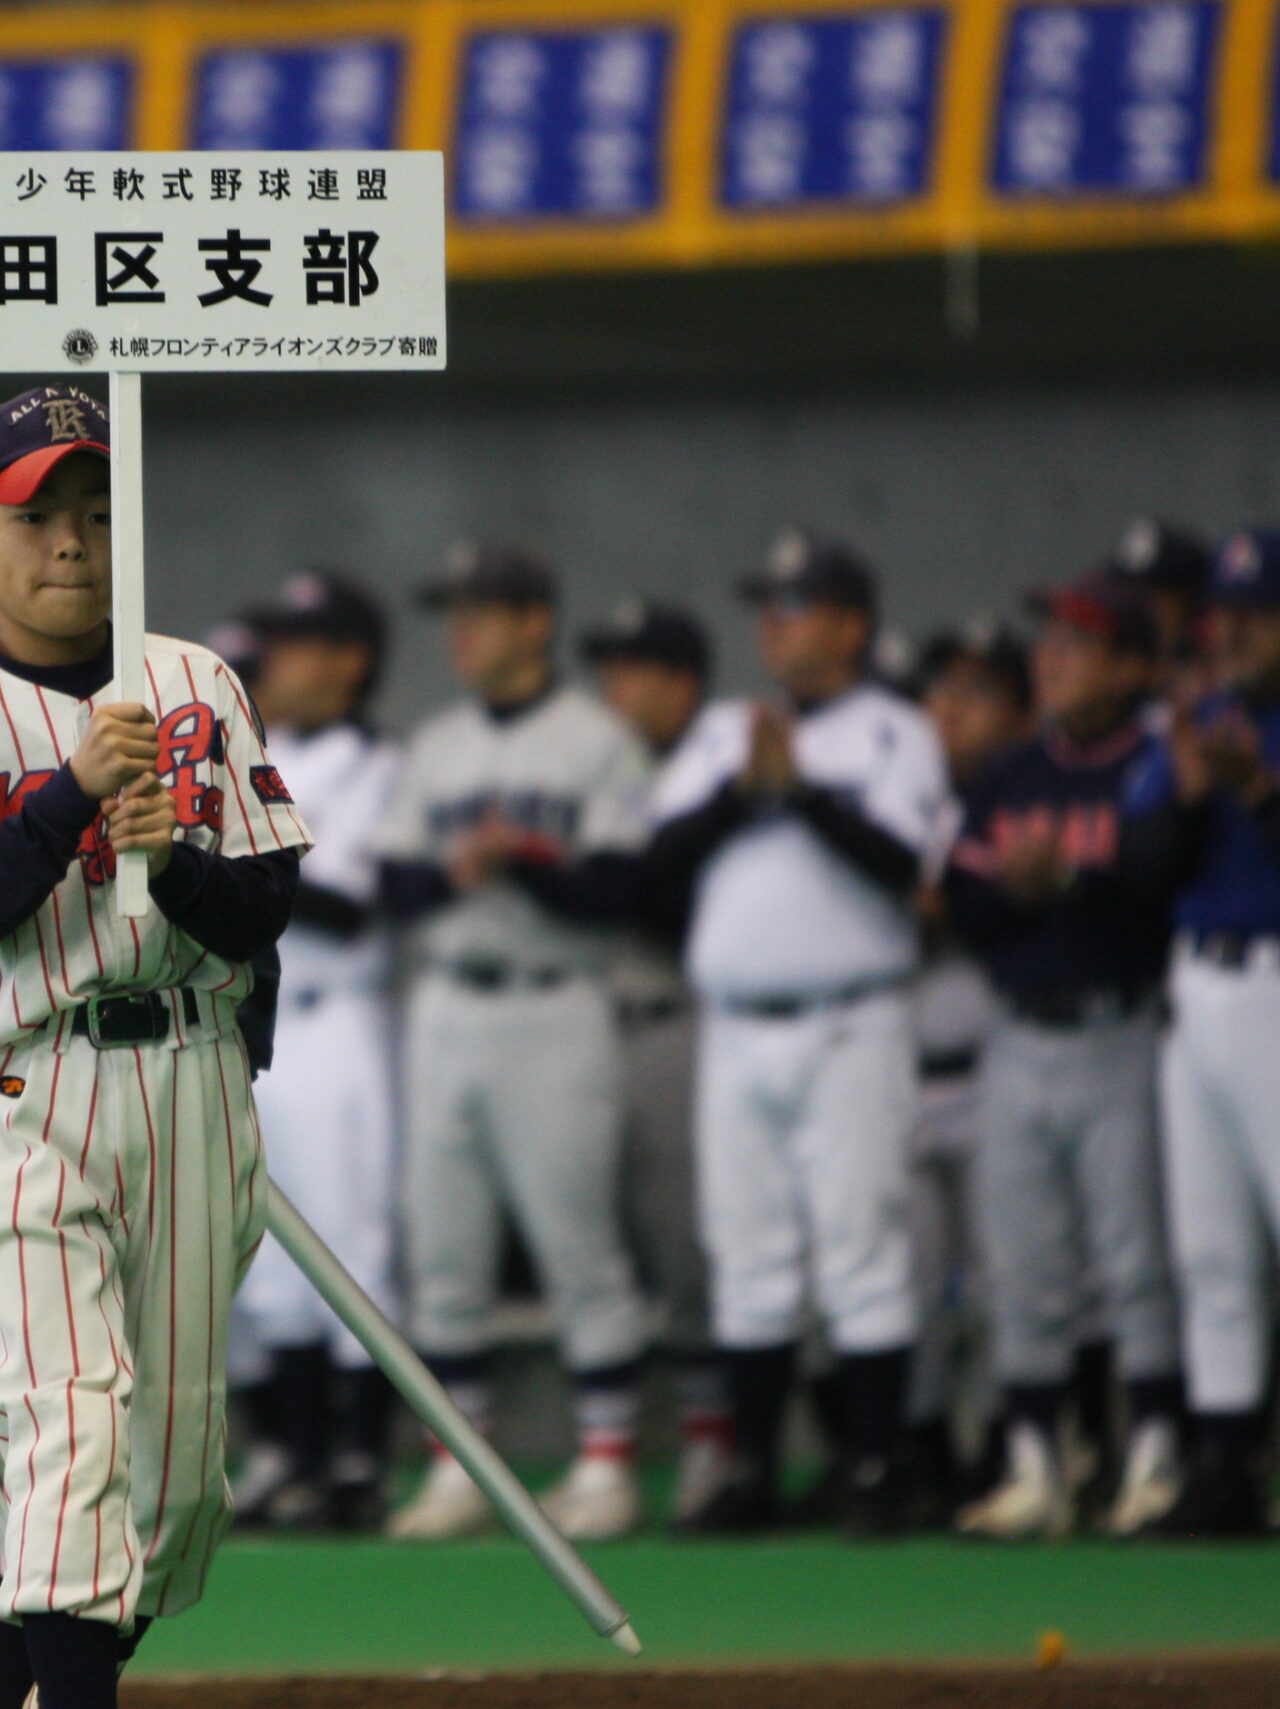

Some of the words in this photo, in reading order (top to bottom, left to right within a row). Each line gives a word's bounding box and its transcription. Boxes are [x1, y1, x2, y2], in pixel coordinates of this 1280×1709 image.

[110, 337, 437, 357] 札幌フロンティアライオンズクラブ寄贈
